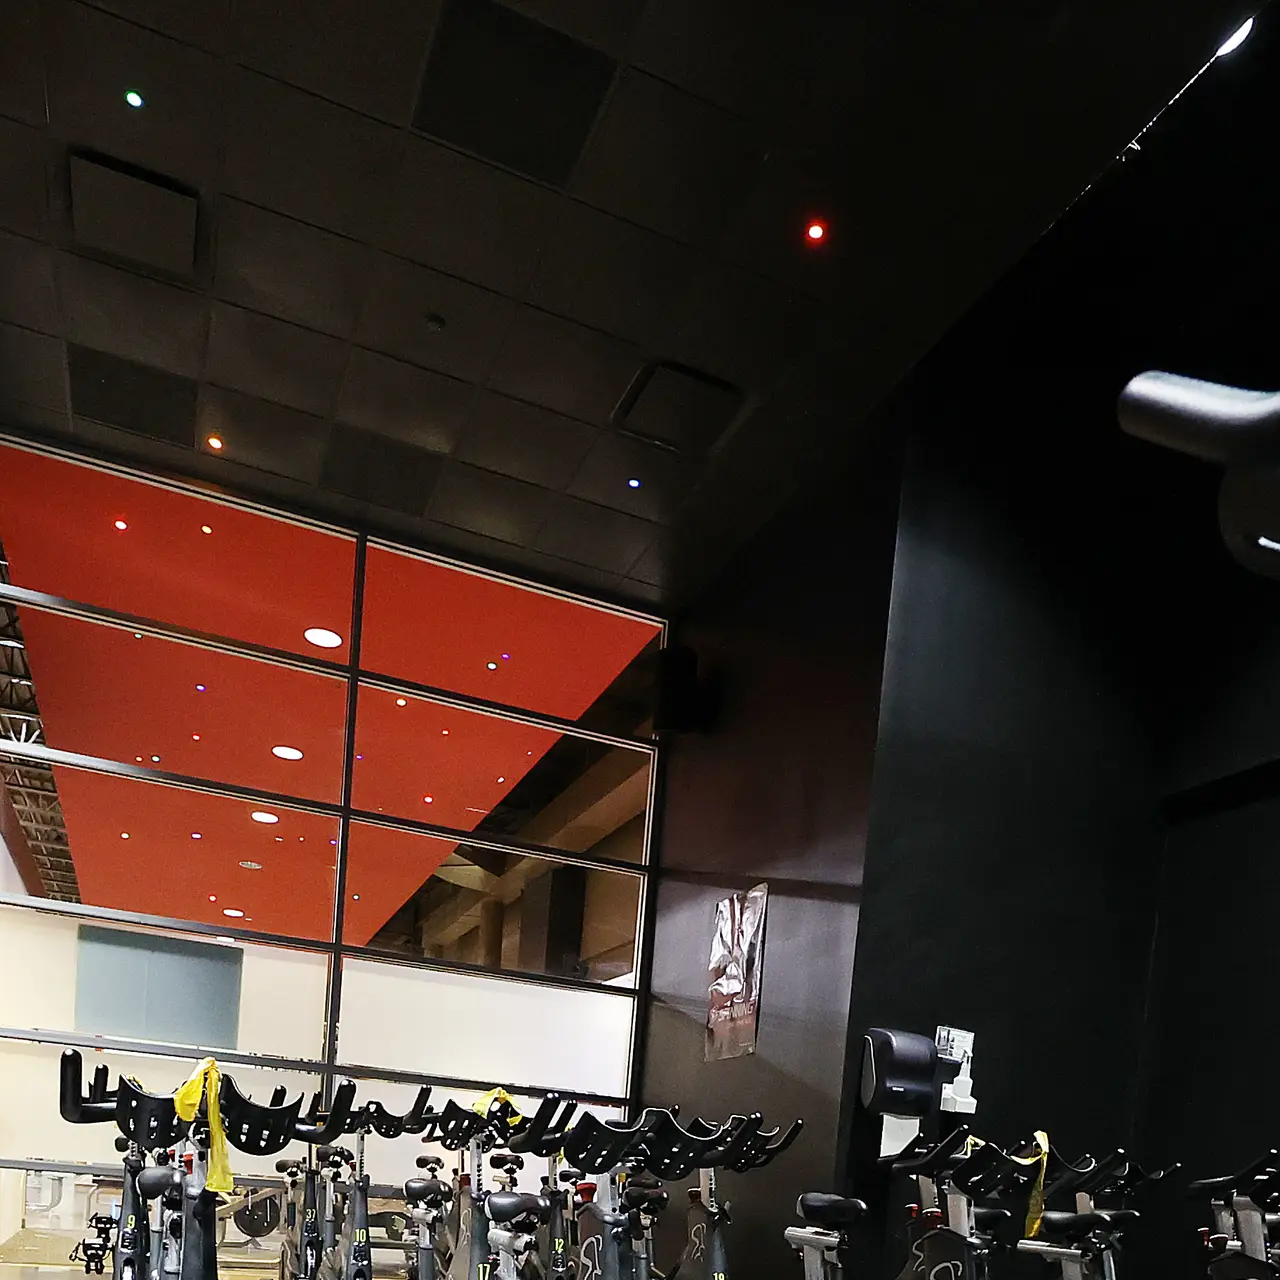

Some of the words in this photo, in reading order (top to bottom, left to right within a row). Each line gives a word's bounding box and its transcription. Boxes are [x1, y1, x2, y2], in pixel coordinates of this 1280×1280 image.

[127, 1214, 136, 1229] 9
[355, 1228, 367, 1242] 10
[554, 1238, 565, 1252] 12
